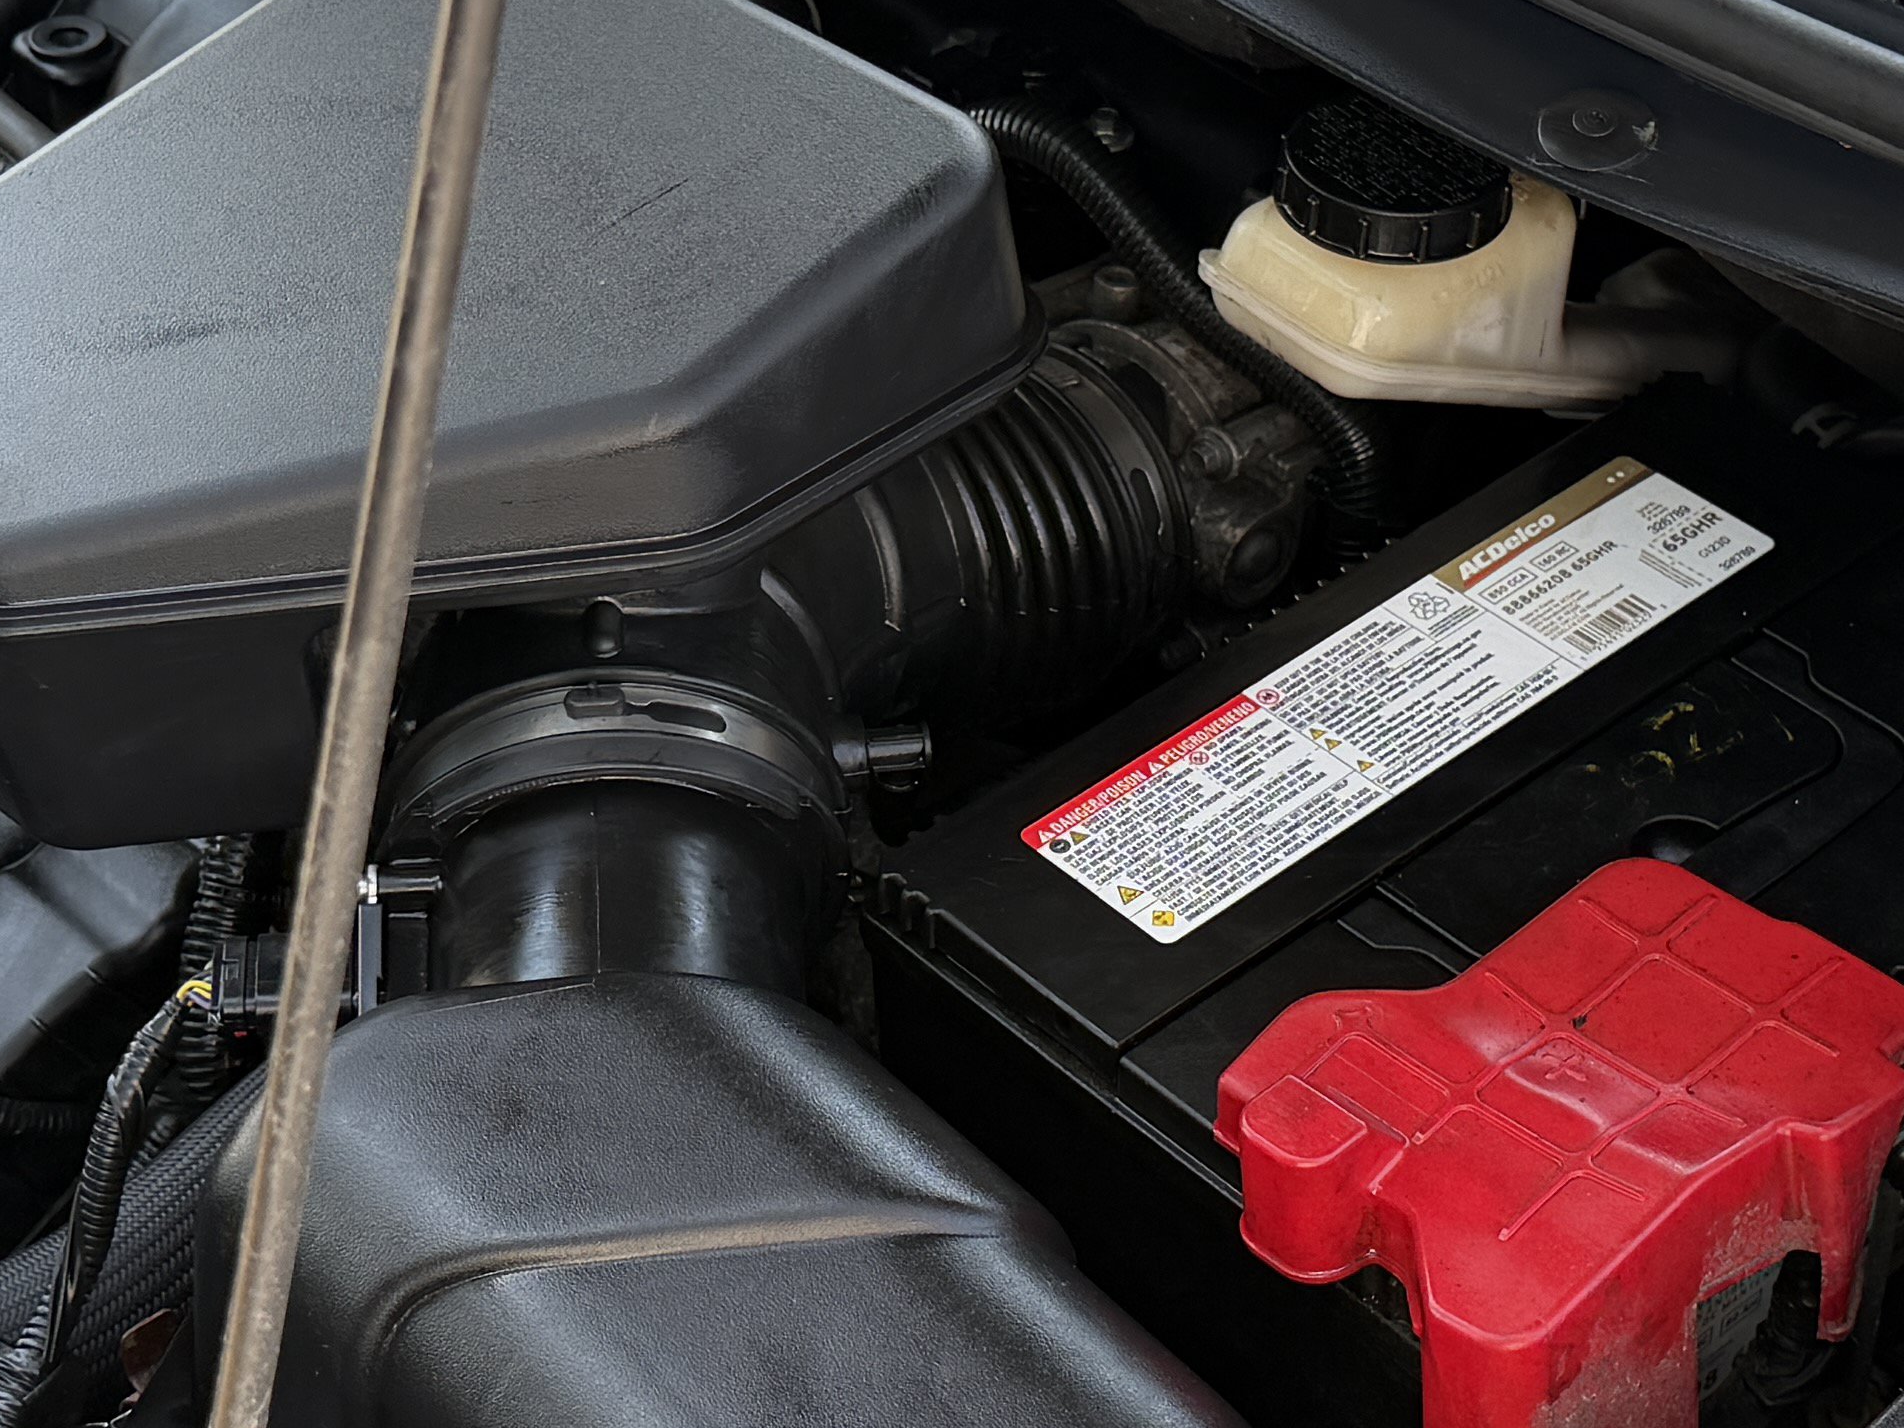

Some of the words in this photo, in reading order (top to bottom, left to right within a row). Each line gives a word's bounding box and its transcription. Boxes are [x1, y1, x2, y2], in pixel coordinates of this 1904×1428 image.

[1457, 513, 1556, 581] ACDelco
[1657, 510, 1724, 553] 65GHR
[1499, 567, 1575, 616] 88866208
[1567, 538, 1620, 572] 65GHR
[1504, 572, 1529, 587] CCA
[1047, 768, 1149, 834] DANGER/POISON
[1156, 700, 1257, 764] PELIGRO/VENENO
